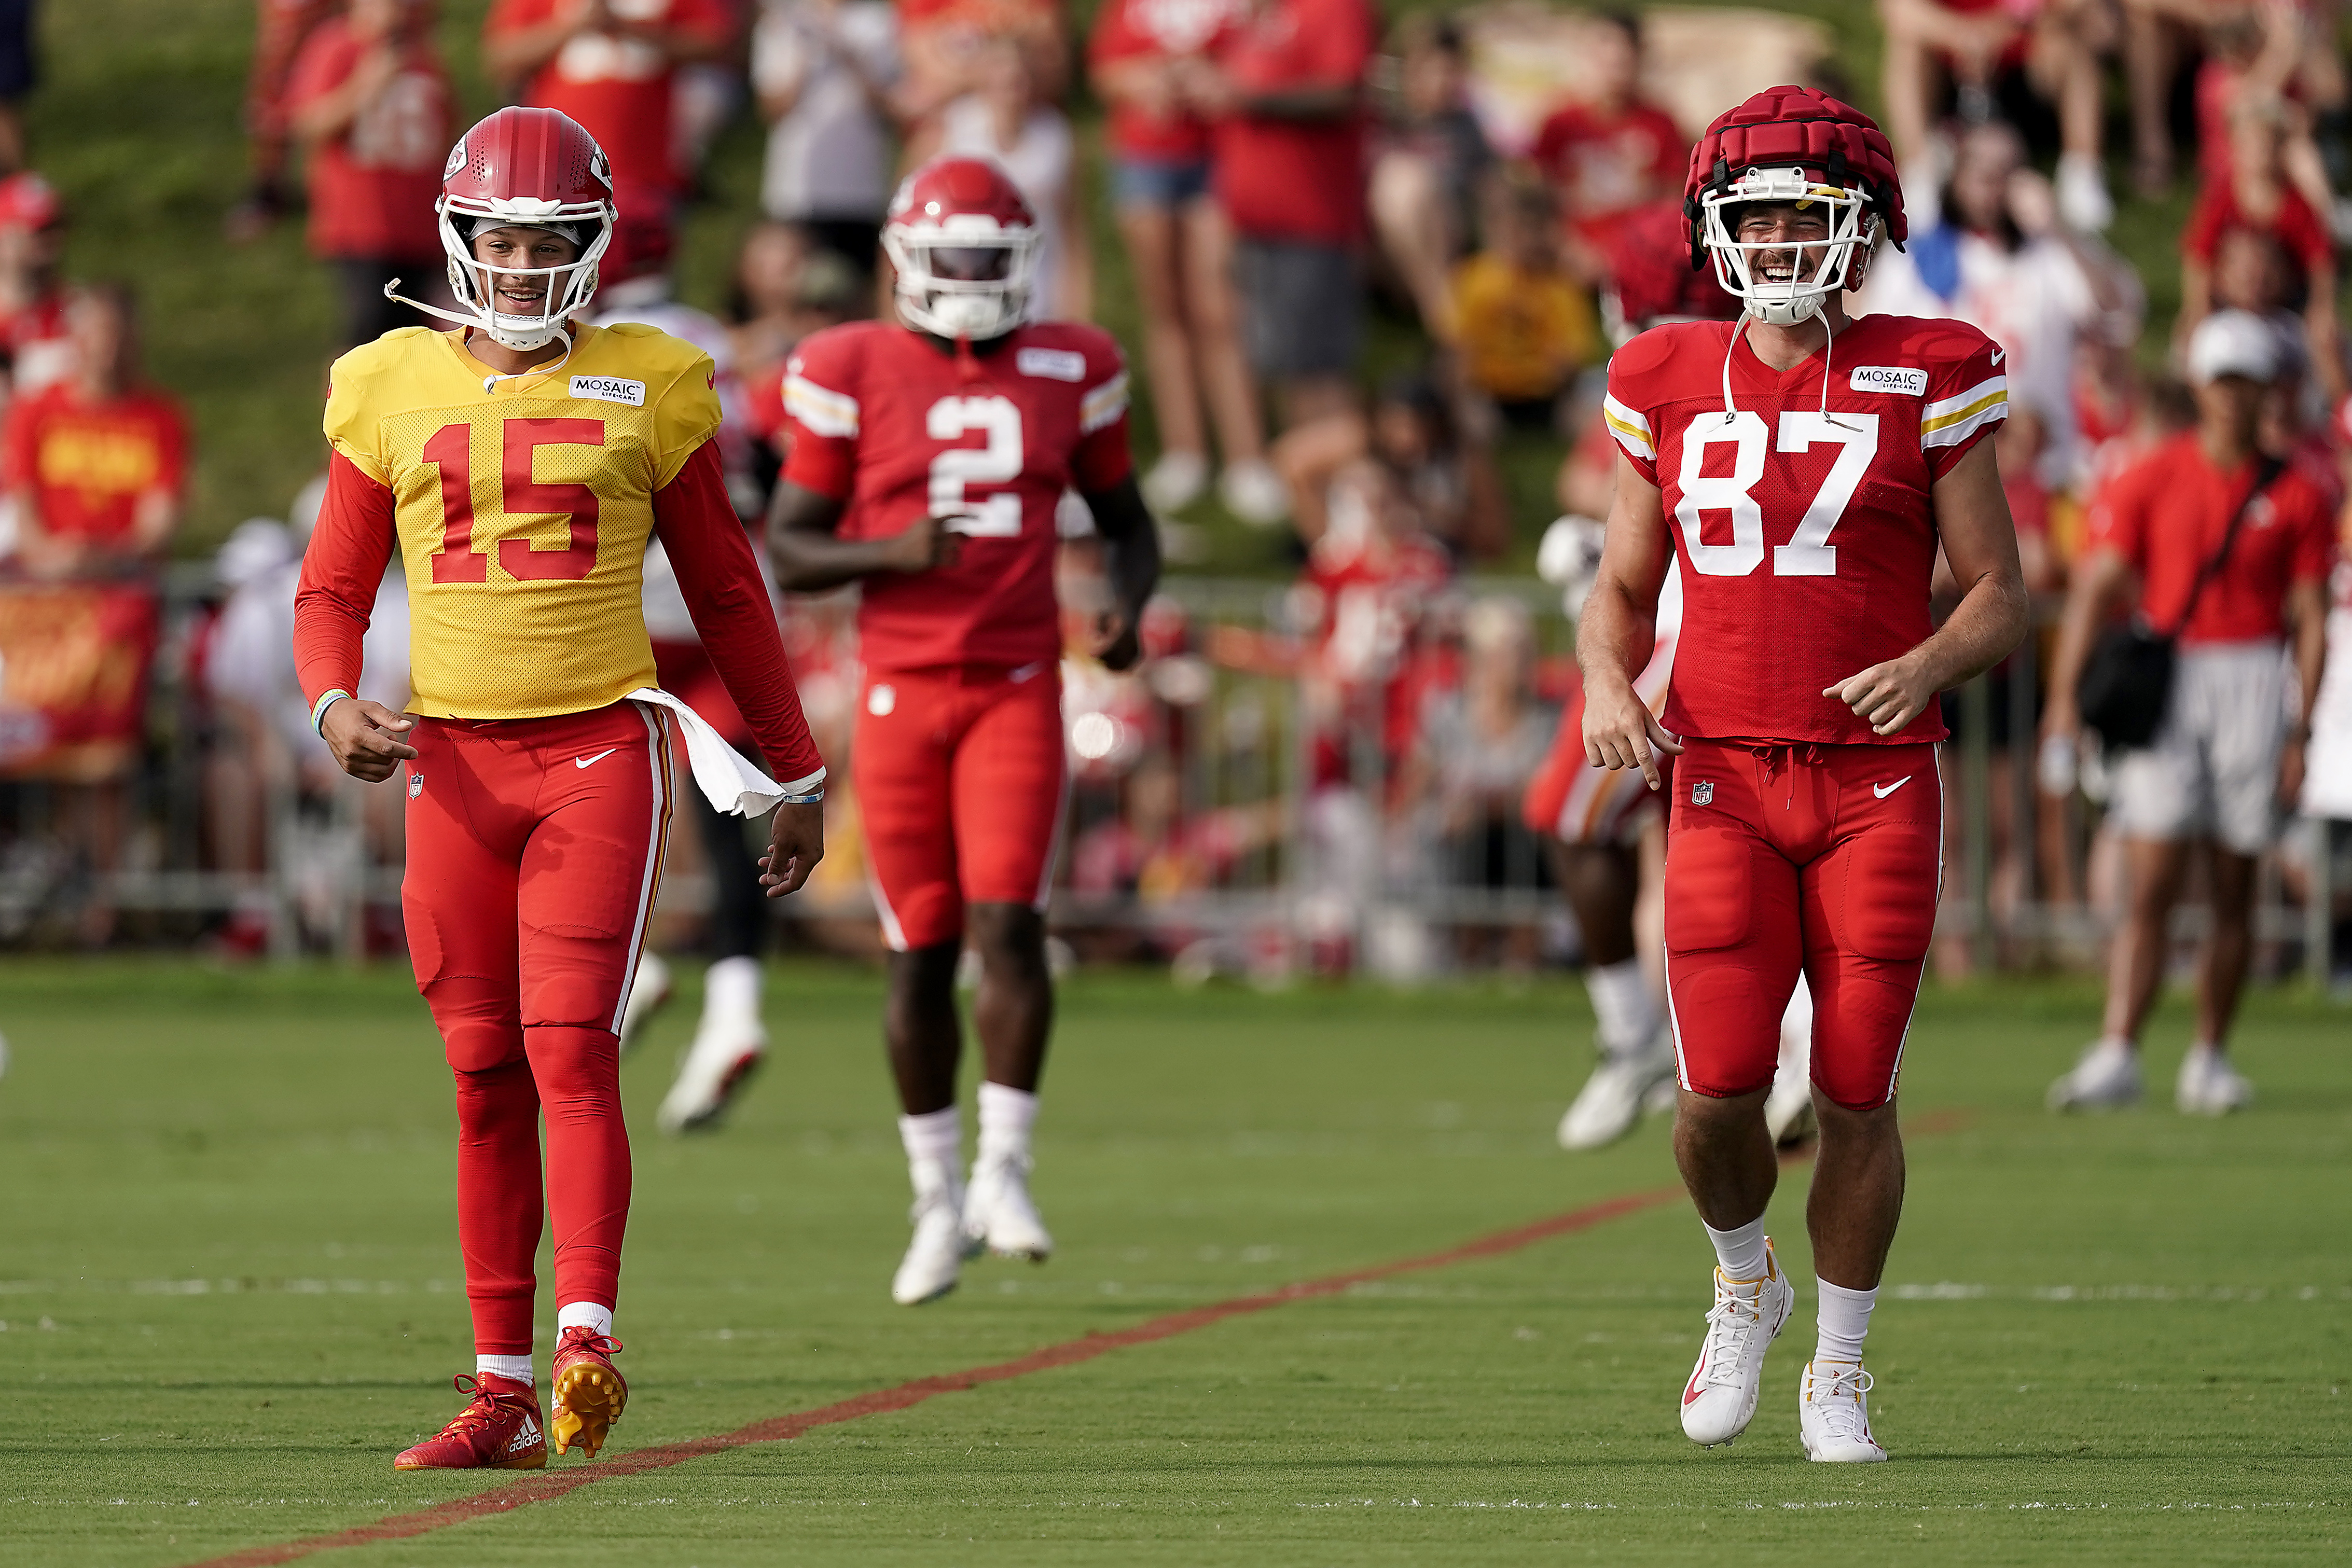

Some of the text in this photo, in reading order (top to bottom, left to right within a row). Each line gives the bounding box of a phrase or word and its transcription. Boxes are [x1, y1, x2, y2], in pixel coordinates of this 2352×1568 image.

[1858, 370, 1917, 384] MOSAIC
[576, 380, 635, 395] MOSAIC
[926, 395, 1023, 538] 2
[422, 418, 605, 584] 15
[1675, 411, 1879, 576] 87
[1695, 792, 1709, 802] NFL
[509, 1432, 542, 1452] adidas
